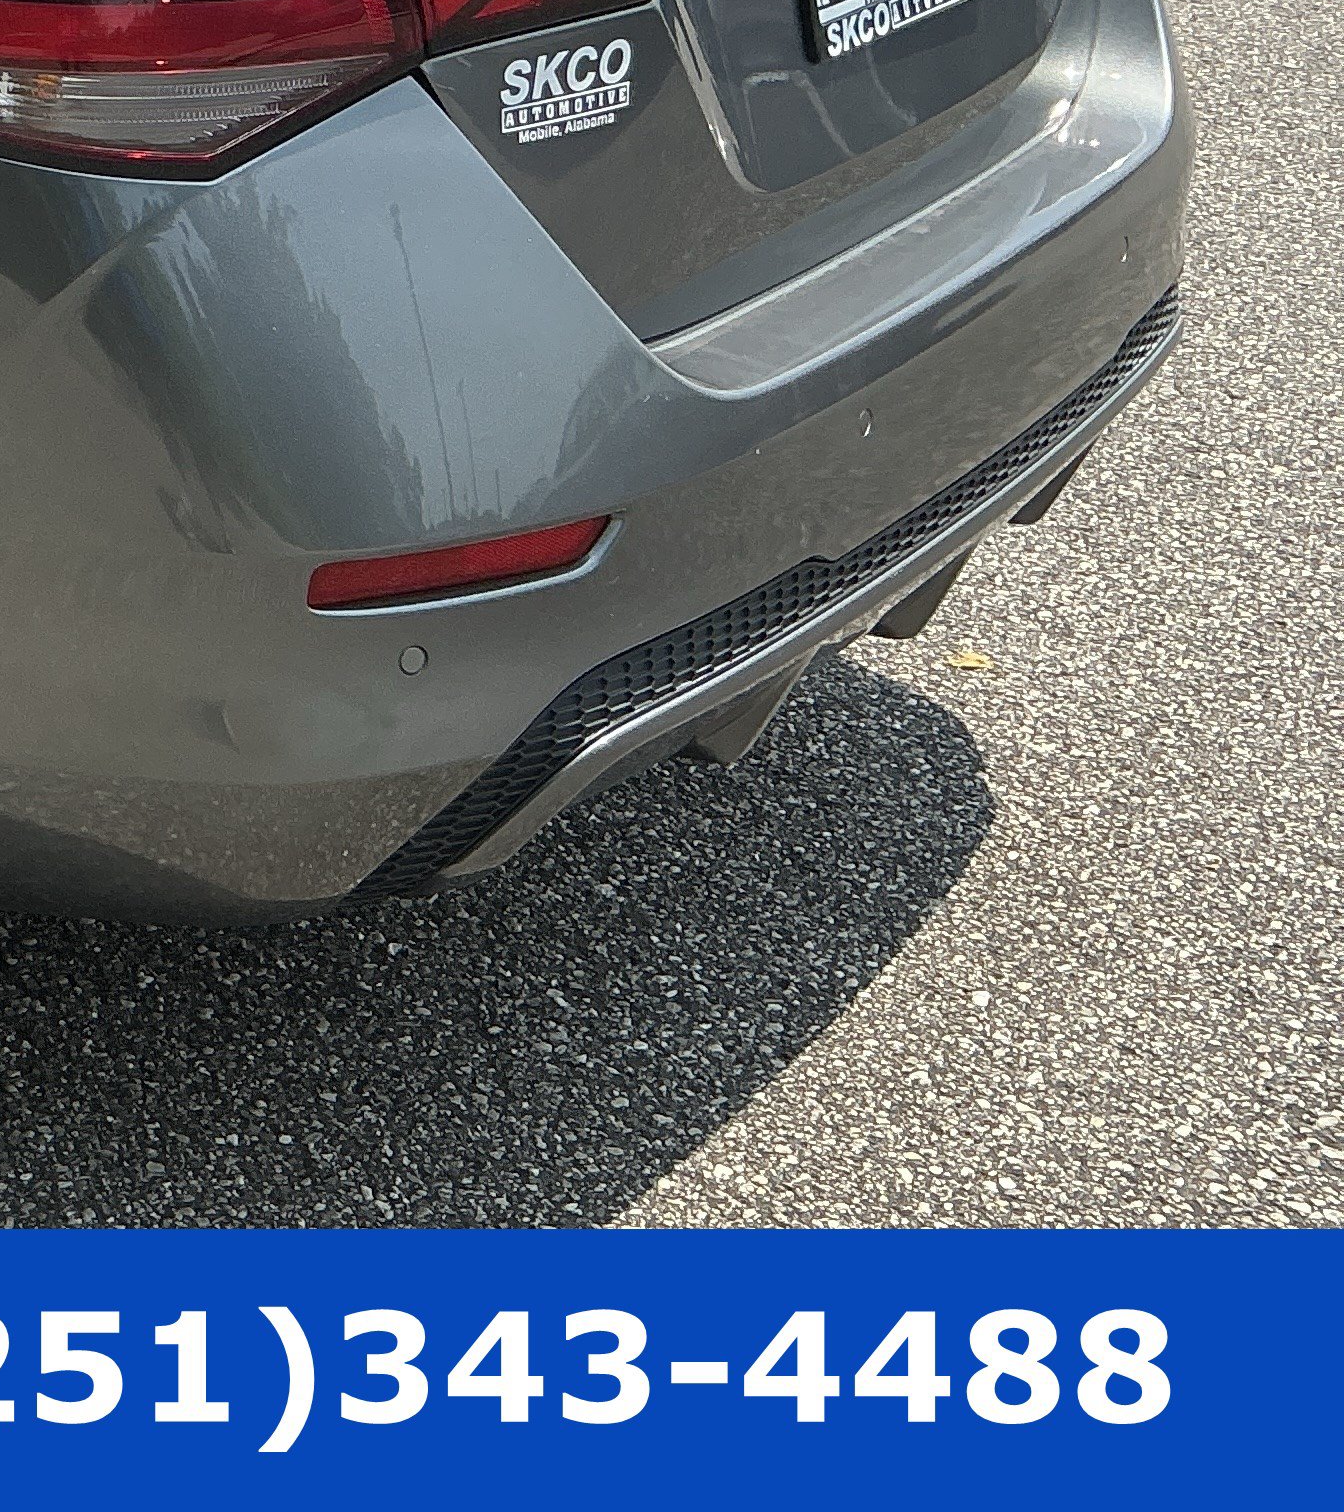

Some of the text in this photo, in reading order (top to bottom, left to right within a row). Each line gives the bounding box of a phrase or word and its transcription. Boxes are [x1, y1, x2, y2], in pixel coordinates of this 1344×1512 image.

[827, 2, 891, 57] SKCO
[500, 38, 631, 106] SKCO
[505, 87, 628, 128] AUTOMOTIVE
[564, 112, 616, 135] Alabama
